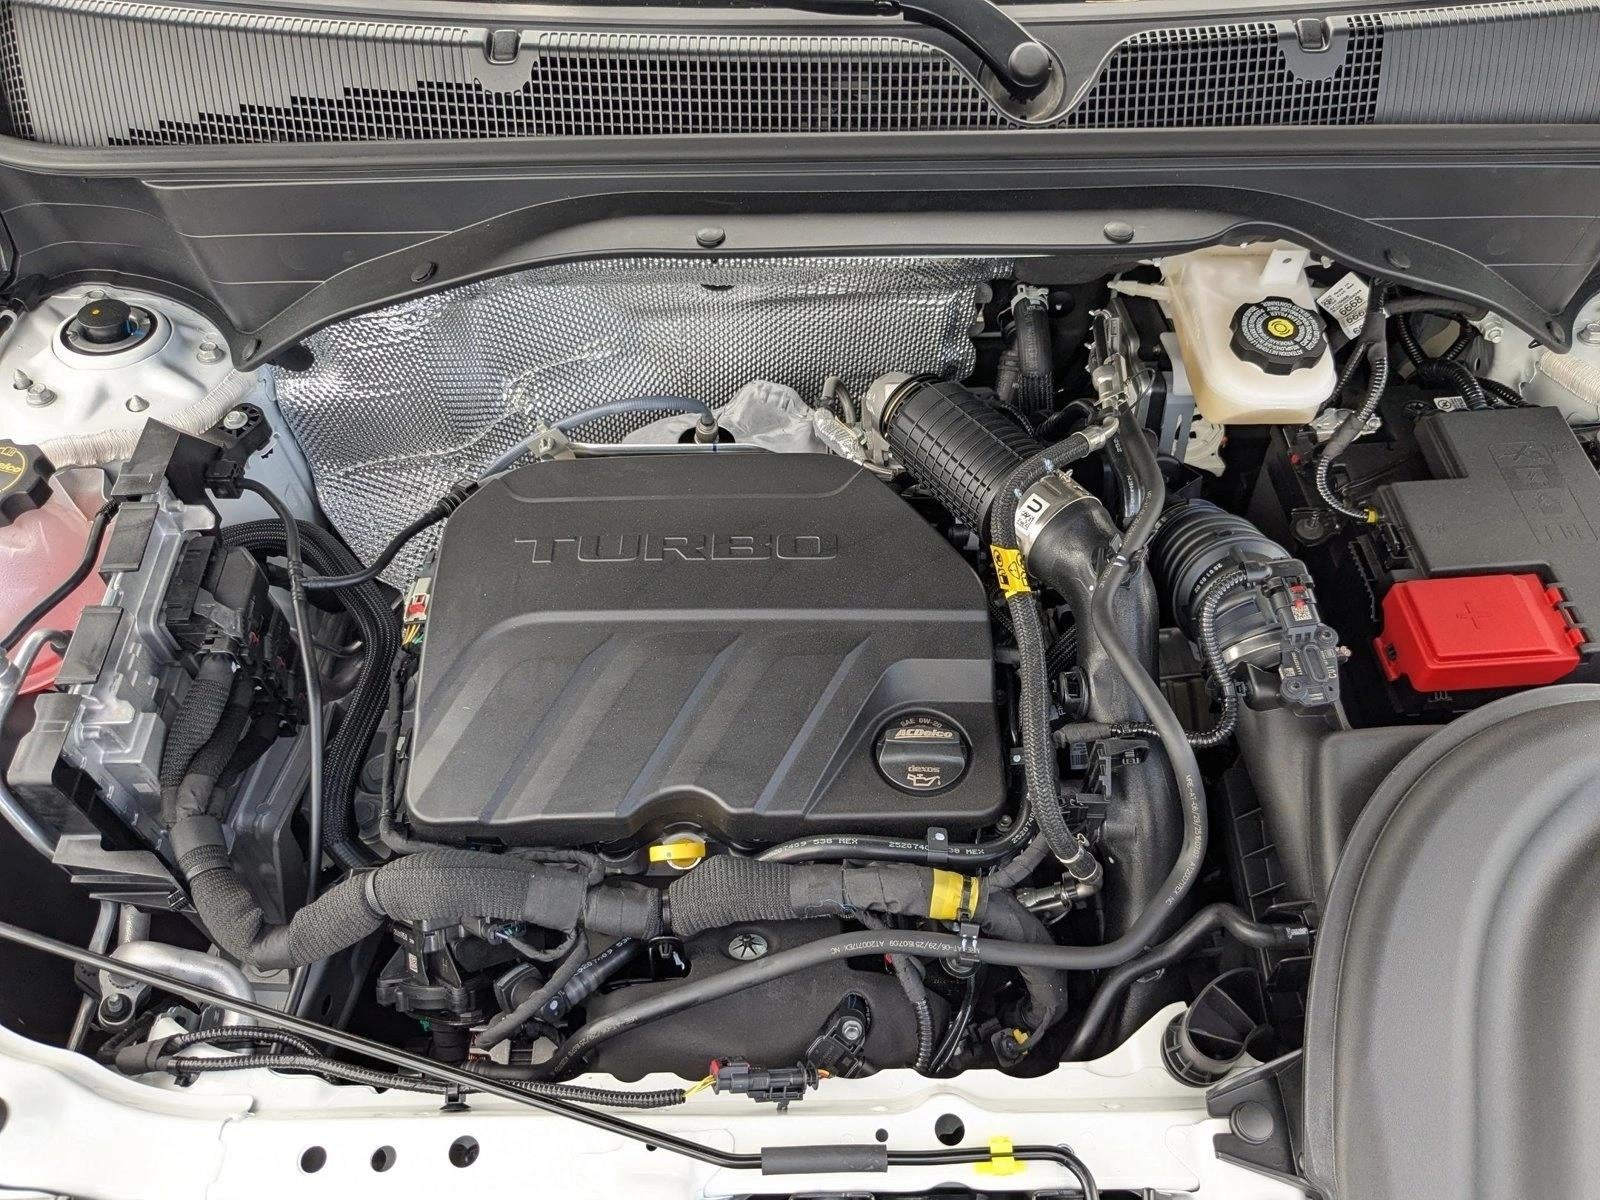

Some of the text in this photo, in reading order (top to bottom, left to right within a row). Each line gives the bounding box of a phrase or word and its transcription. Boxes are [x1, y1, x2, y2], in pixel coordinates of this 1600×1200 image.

[1027, 498, 1043, 513] U
[514, 533, 838, 563] TURBO
[900, 717, 943, 729] SAE 0W-20
[894, 728, 955, 740] ACDelco
[907, 764, 940, 773] dexos
[888, 841, 929, 851] 2520740
[965, 848, 985, 856] MEX
